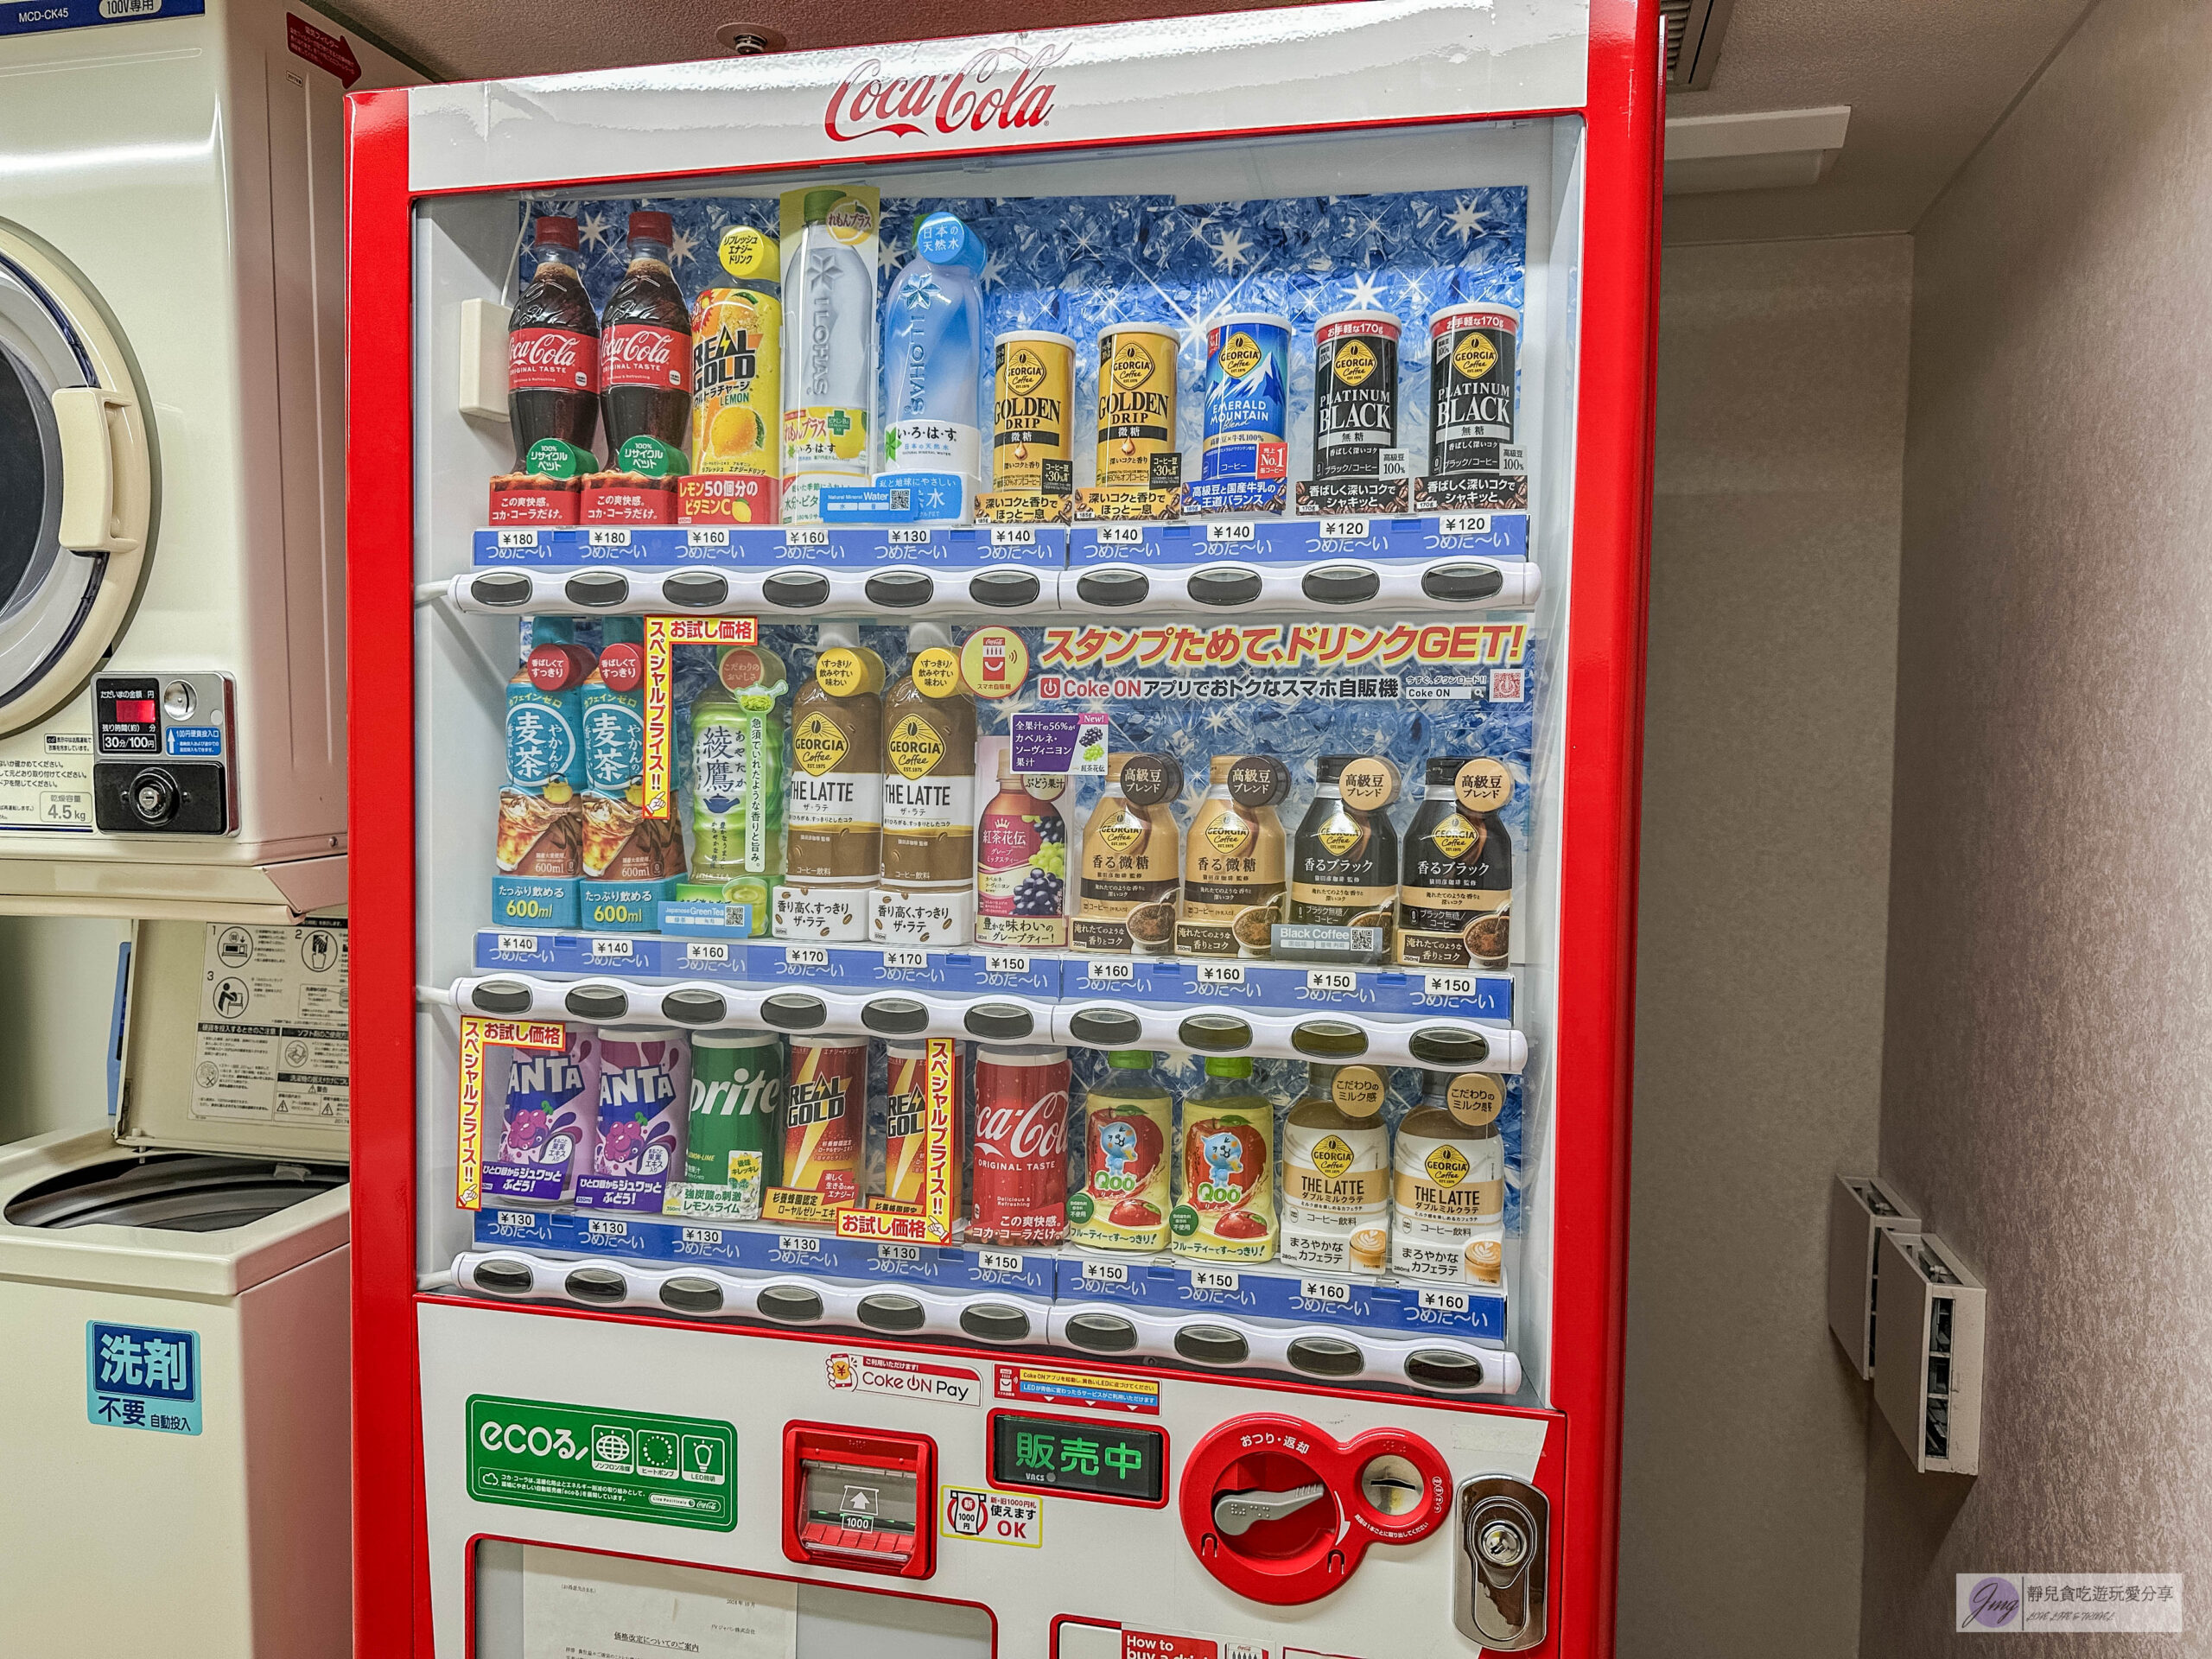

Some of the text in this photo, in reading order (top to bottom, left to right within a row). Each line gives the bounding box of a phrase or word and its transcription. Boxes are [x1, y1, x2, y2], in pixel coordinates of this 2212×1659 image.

[105, 0, 155, 16] 100V専用
[18, 8, 69, 23] MCD-CK45
[825, 42, 1072, 142] Coca-Cola
[828, 214, 872, 229] れもんプラス
[923, 226, 959, 238] 日本の
[923, 238, 960, 253] 天然水
[1327, 322, 1383, 338] お手軽な170g
[720, 392, 749, 406] LEMON
[1319, 389, 1391, 409] PLATINUM
[1438, 382, 1510, 402] PLATINUM
[995, 397, 1062, 426] GOLDEN
[1098, 391, 1169, 420] GOLDEN
[1213, 401, 1267, 415] EMERALD
[1437, 396, 1511, 427] BLACK
[1006, 418, 1041, 429] DRIP
[1112, 412, 1149, 423] DRIP
[1211, 411, 1268, 424] MOUNTAIN
[1319, 403, 1391, 433] BLACK
[531, 451, 569, 462] リサイクル
[538, 460, 562, 471] ペット
[679, 480, 758, 499] レモン50個分の
[1192, 481, 1276, 498] 高級豆と国産牛乳の
[1309, 484, 1395, 498] 香ばしく深いコクで
[1427, 478, 1516, 493] 香ばしく深いコクで
[864, 491, 889, 501] Water
[1202, 494, 1264, 509] 王道バランス
[1326, 496, 1379, 509] シャキッと
[685, 499, 731, 516] ビタミンC
[985, 498, 1058, 509] 深いコクと香りで
[996, 510, 1045, 520] ほっと一息
[1325, 522, 1363, 536] ¥120
[1446, 518, 1485, 531] ¥120
[503, 533, 533, 545] ¥180
[594, 531, 625, 544] ¥180
[692, 529, 724, 543] ¥160
[790, 531, 825, 543] ¥160
[892, 530, 926, 543] ¥130
[996, 531, 1030, 543] ¥140
[1103, 528, 1138, 541] ¥140
[1213, 525, 1250, 539] ¥140
[671, 620, 753, 640] お試し価格
[1042, 624, 1528, 664] スタンプためて、ドリンクGET!
[531, 658, 564, 668] 香ばしくて
[531, 668, 564, 678] すっきり
[819, 670, 854, 678] 飲みやすい
[825, 678, 848, 687] 味わい
[1064, 679, 1109, 698] Coke
[1408, 688, 1451, 697] Coke ON
[649, 620, 666, 791] スペシャルプライス!!
[1084, 714, 1105, 723] New!
[1015, 721, 1076, 732] 全果汁の56%が
[105, 736, 155, 749] 30分/100円
[516, 711, 549, 779] 麦茶
[795, 738, 846, 752] GEORGIA
[1015, 746, 1071, 755] ソーヴィニヨン
[1016, 757, 1035, 767] 果汁
[1081, 765, 1105, 773] 紅茶花伝
[1124, 768, 1162, 783] 高級豆
[750, 717, 763, 868] 急須でいれたような香りと旨み。
[791, 780, 854, 803] THE LATTE
[1127, 782, 1160, 793] ブレンド
[50, 794, 81, 803] 乾燥容量
[885, 784, 950, 806] THE LATTE
[48, 804, 72, 819] 4.5
[74, 810, 86, 822] kg
[982, 830, 1027, 846] 紅茶花伝
[535, 862, 564, 874] 600ml
[1092, 855, 1149, 871] 香る微糖
[1304, 858, 1374, 874] 香るブラック
[797, 867, 832, 876] コーヒー飲料
[499, 884, 564, 899] たっぷり飲める
[506, 899, 553, 919] 600ml
[778, 900, 849, 915] 香り高く、すっきり
[983, 917, 1053, 932] 豊かな味わいの
[295, 929, 302, 939] 2
[1280, 928, 1350, 941] Black Coffee
[503, 937, 533, 950] ¥140
[597, 941, 629, 954] ¥140
[692, 945, 724, 957] ¥160
[791, 949, 824, 963] ¥170
[887, 953, 923, 966] ¥170
[991, 957, 1025, 970] ¥150
[207, 970, 214, 981] 3
[1094, 964, 1128, 977] ¥160
[1205, 966, 1241, 981] ¥160
[1313, 974, 1351, 988] ¥150
[1431, 977, 1471, 993] ¥150
[484, 1023, 561, 1046] お試し価格
[600, 1067, 675, 1107] ANTA
[790, 1075, 843, 1103] REAL
[462, 1021, 480, 1183] スペシャルプライス!!
[1338, 1091, 1377, 1103] ミルク感
[789, 1096, 845, 1126] GOLD
[930, 1041, 950, 1216] スペシャルプライス!!
[978, 1159, 1056, 1172] ORIGINAL TASTE
[1094, 1171, 1137, 1191] Qoo
[684, 1188, 742, 1202] 強炭酸の刺激
[1302, 1192, 1364, 1204] ダブルミルクラテ
[500, 1211, 532, 1226] ¥130
[842, 1213, 926, 1238] お試し価格
[592, 1220, 625, 1234] ¥130
[685, 1228, 720, 1243] ¥130
[782, 1236, 817, 1250] ¥130
[1289, 1236, 1344, 1253] まろやかな
[881, 1244, 918, 1260] ¥130
[1298, 1251, 1344, 1264] カフェラテ
[983, 1253, 1019, 1269] ¥150
[1088, 1263, 1123, 1280] ¥150
[1196, 1270, 1233, 1287] ¥150
[1306, 1281, 1345, 1299] ¥160
[1425, 1291, 1465, 1310] ¥160
[100, 1333, 188, 1391] 洗剤
[865, 1357, 919, 1371] ご利用いただけます!
[862, 1370, 969, 1402] Coke ON Pay
[98, 1395, 191, 1432] 不要 自動投入
[1240, 1431, 1311, 1455] おつり・返却
[1015, 1431, 1142, 1479] 販売中
[594, 1461, 631, 1472] ノンフロン冷媒
[642, 1467, 675, 1478] ヒートポンプ
[690, 1473, 715, 1483] LED照明
[990, 1496, 1037, 1510] 新・旧1000円札
[958, 1513, 976, 1522] 1000
[990, 1504, 1037, 1520] 使えます
[845, 1516, 869, 1530] 1000
[997, 1520, 1027, 1539] OK
[613, 1630, 700, 1652] 価格改定についてのご案内
[1126, 1635, 1174, 1651] How to
